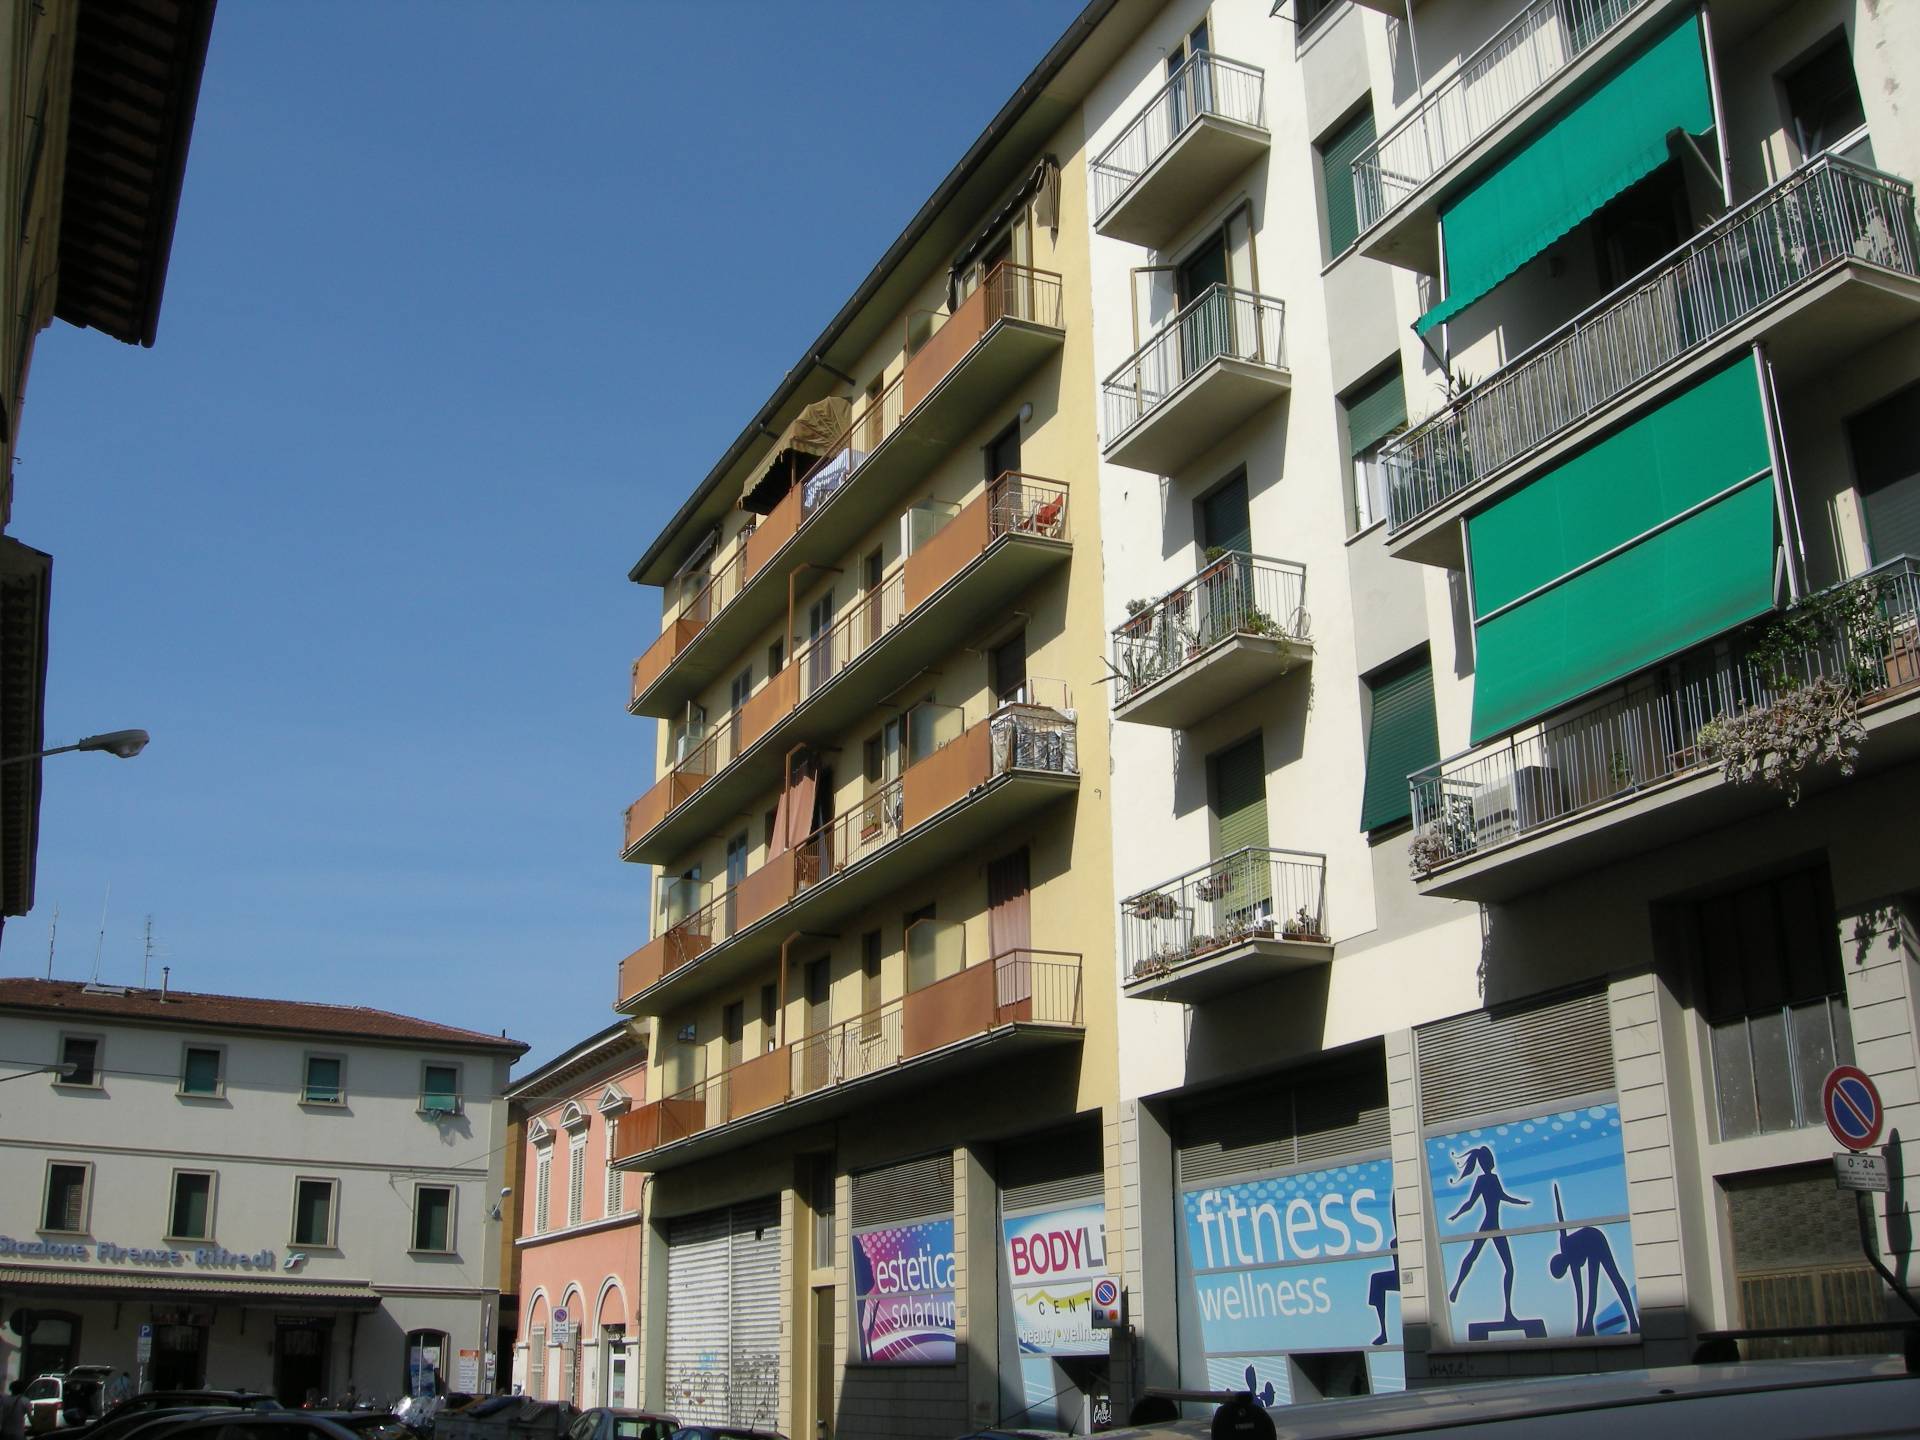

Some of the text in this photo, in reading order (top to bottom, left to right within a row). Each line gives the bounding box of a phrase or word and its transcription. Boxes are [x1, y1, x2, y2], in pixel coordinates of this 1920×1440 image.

[1847, 1158, 1854, 1168] 0
[1862, 1158, 1875, 1169] 24
[1198, 1188, 1384, 1268] fitness
[0, 1235, 274, 1269] Stazione Firenze Rifredi
[876, 1243, 956, 1294] estetica
[1199, 1273, 1332, 1321] wellness
[142, 1325, 150, 1336] P
[1022, 1320, 1109, 1348] beauty wellness
